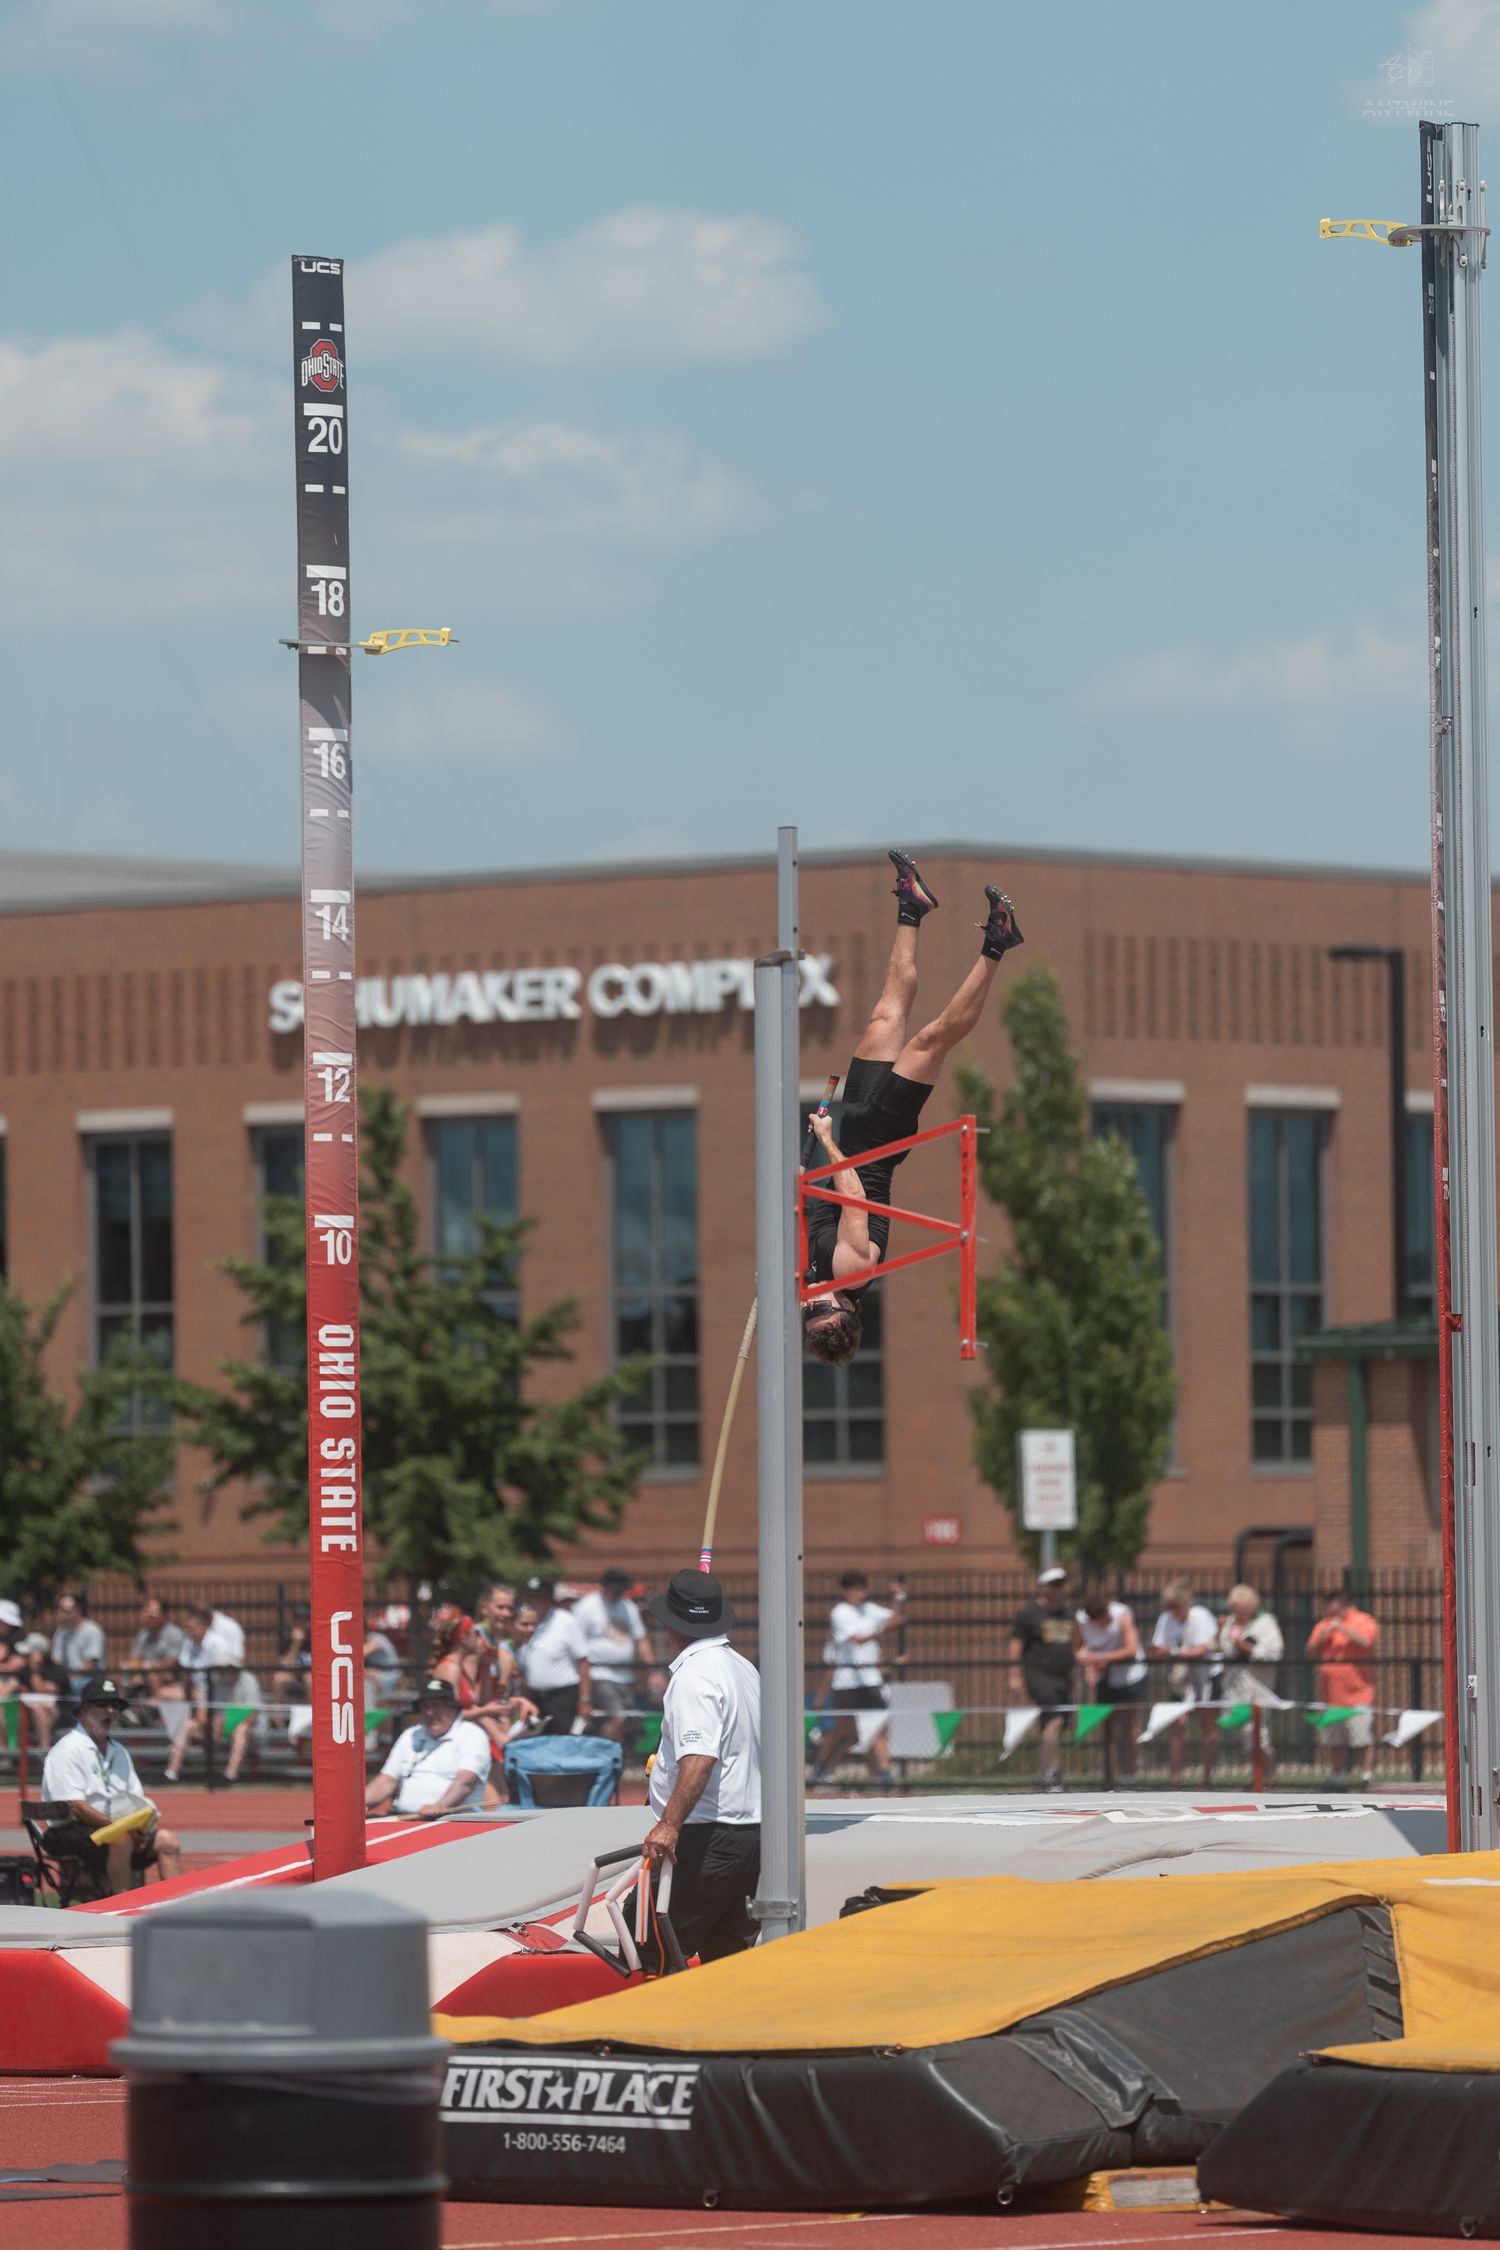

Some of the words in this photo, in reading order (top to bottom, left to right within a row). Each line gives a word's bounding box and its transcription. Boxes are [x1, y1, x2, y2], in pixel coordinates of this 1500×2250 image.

[301, 261, 341, 275] UCS
[308, 417, 343, 454] 20
[310, 579, 344, 617] 18
[313, 742, 346, 779] 16
[315, 905, 349, 941] 14
[318, 1067, 351, 1102] 12
[320, 1230, 352, 1264] 10
[318, 1324, 356, 1418] OHIO
[320, 1438, 357, 1552] STATE
[330, 1611, 355, 1744] UCS
[439, 2067, 555, 2110] FIRST
[569, 2070, 699, 2116] PLACE
[503, 2132, 627, 2153] 1-800-556-7464
